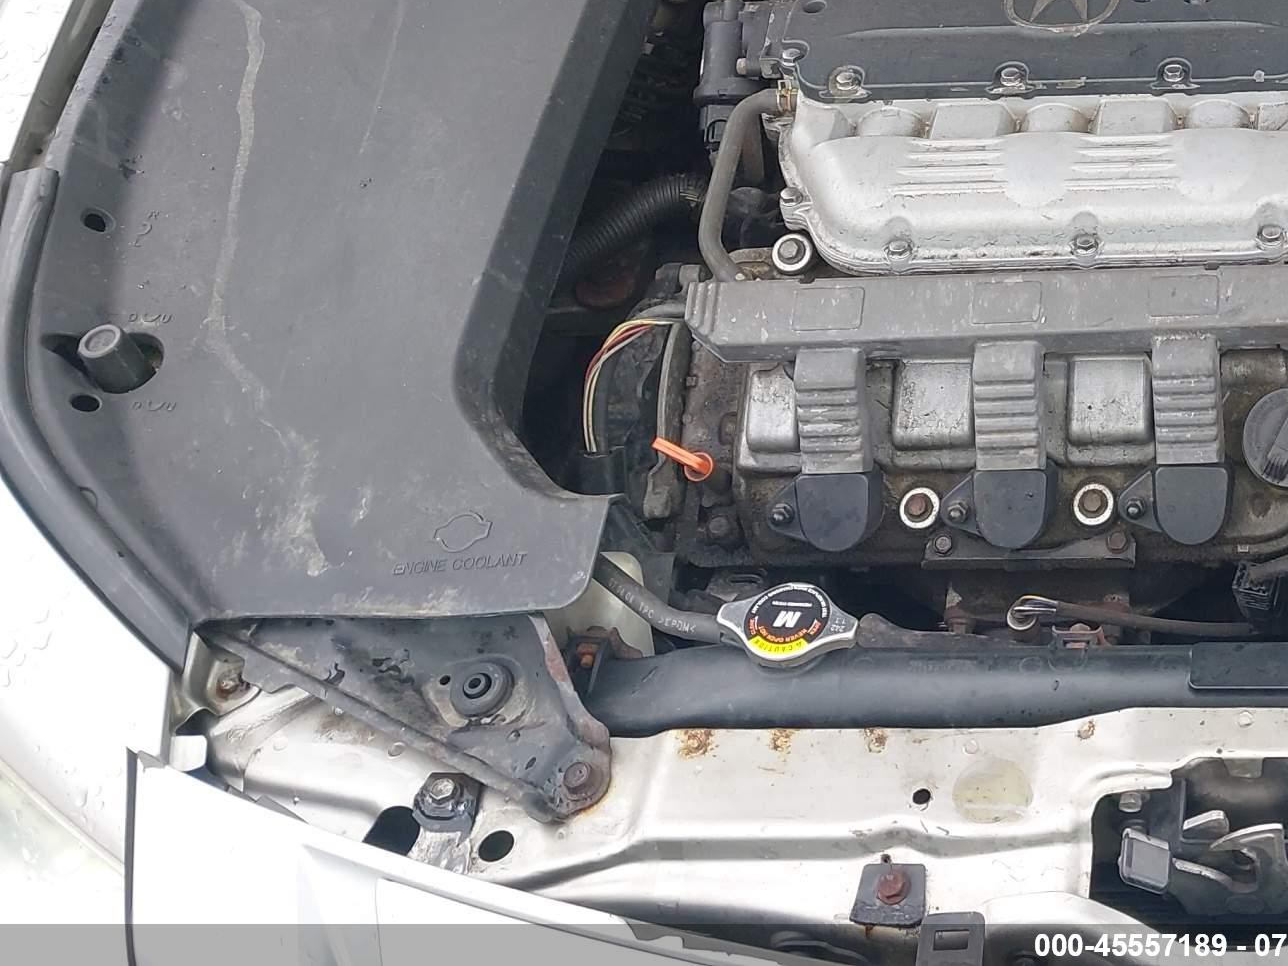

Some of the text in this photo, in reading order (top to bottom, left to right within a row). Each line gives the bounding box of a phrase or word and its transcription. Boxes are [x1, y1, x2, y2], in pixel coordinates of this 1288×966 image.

[393, 552, 527, 575] ENGINE COOLANT
[773, 610, 802, 628] M
[786, 628, 807, 642] NEVER
